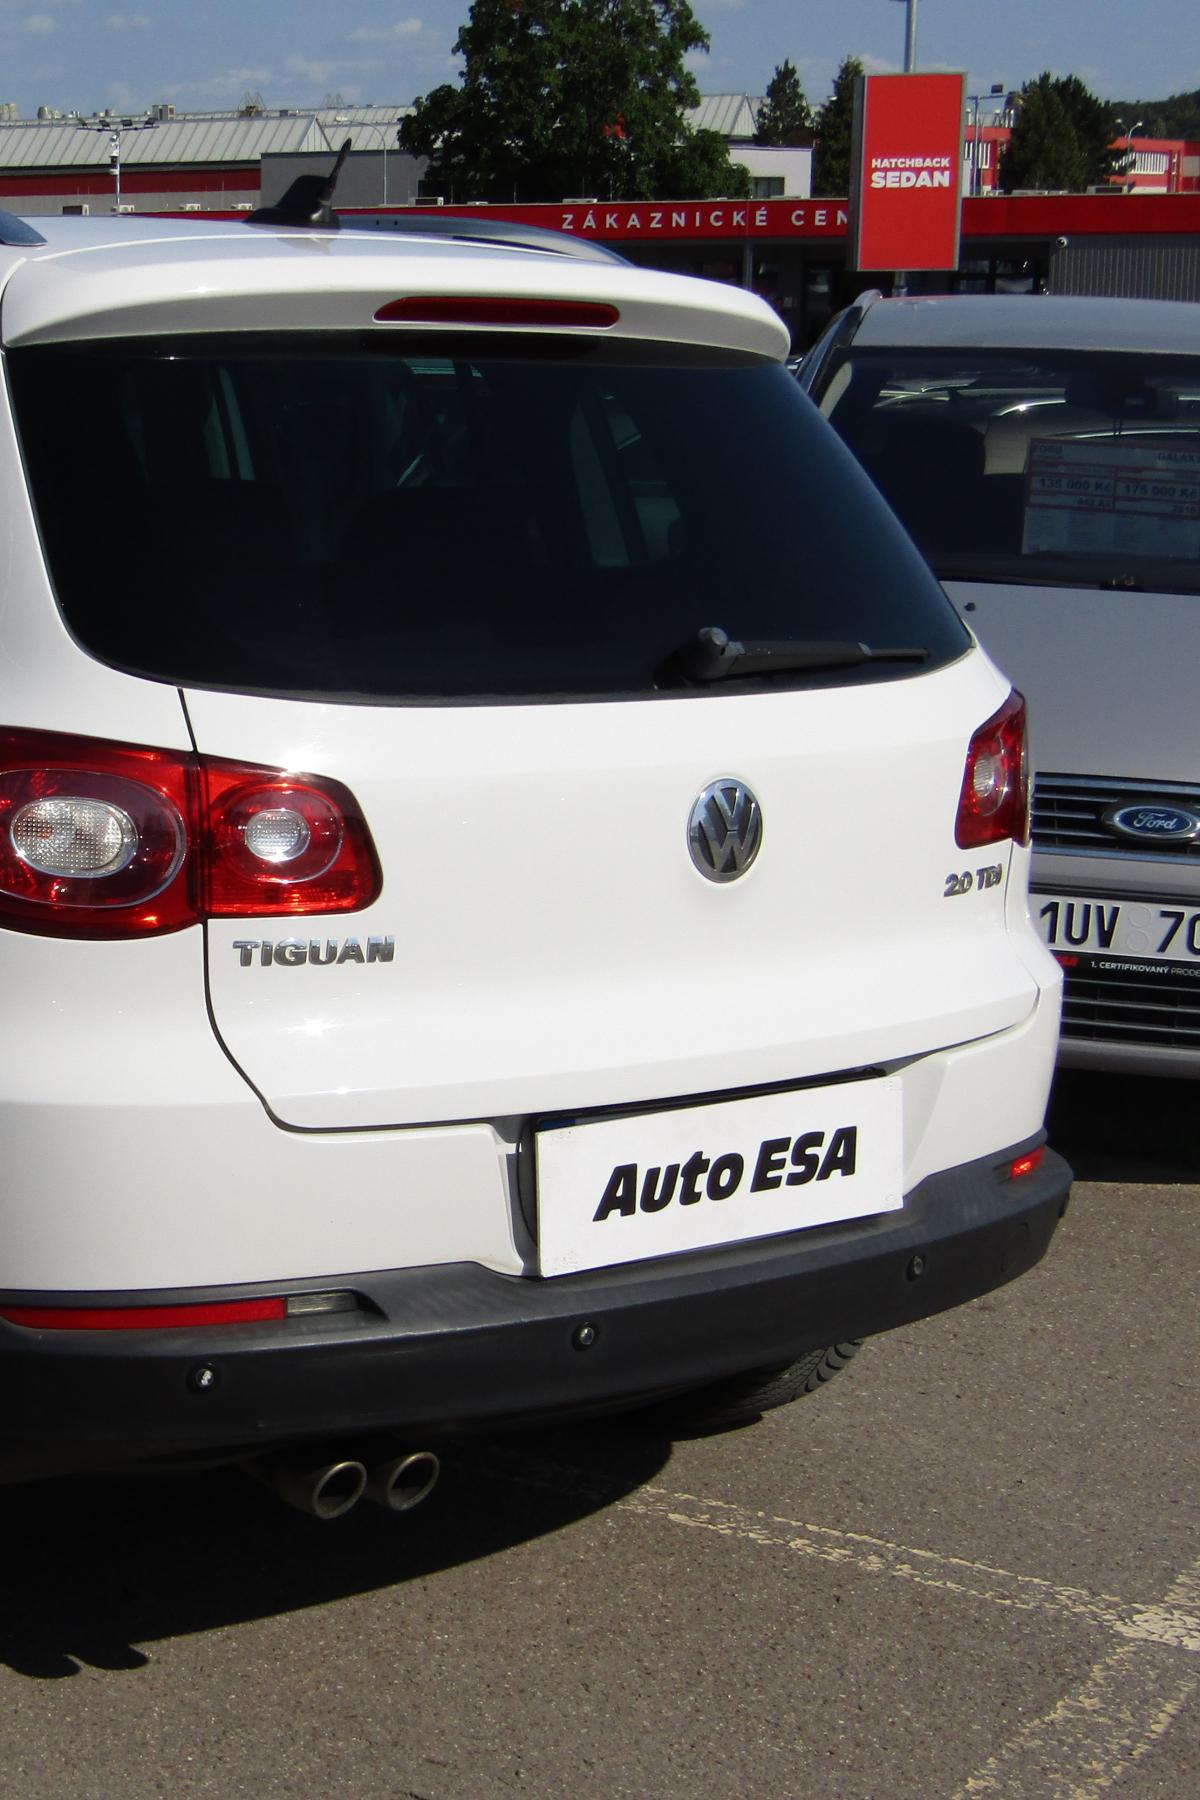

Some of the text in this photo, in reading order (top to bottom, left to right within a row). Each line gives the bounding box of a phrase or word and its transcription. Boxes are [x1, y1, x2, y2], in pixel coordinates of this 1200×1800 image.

[871, 157, 950, 168] HATCHBACK
[870, 170, 950, 188] SEDAN
[561, 206, 848, 229] ZÁKAZNICKÉ CEN
[1133, 812, 1178, 830] Ford
[976, 863, 1003, 891] TDI
[1040, 901, 1121, 949] 1UV
[232, 934, 396, 967] TIGUAN
[1099, 961, 1170, 974] CERTIFIKOVANÝ
[592, 1125, 858, 1222] Auto ESA
